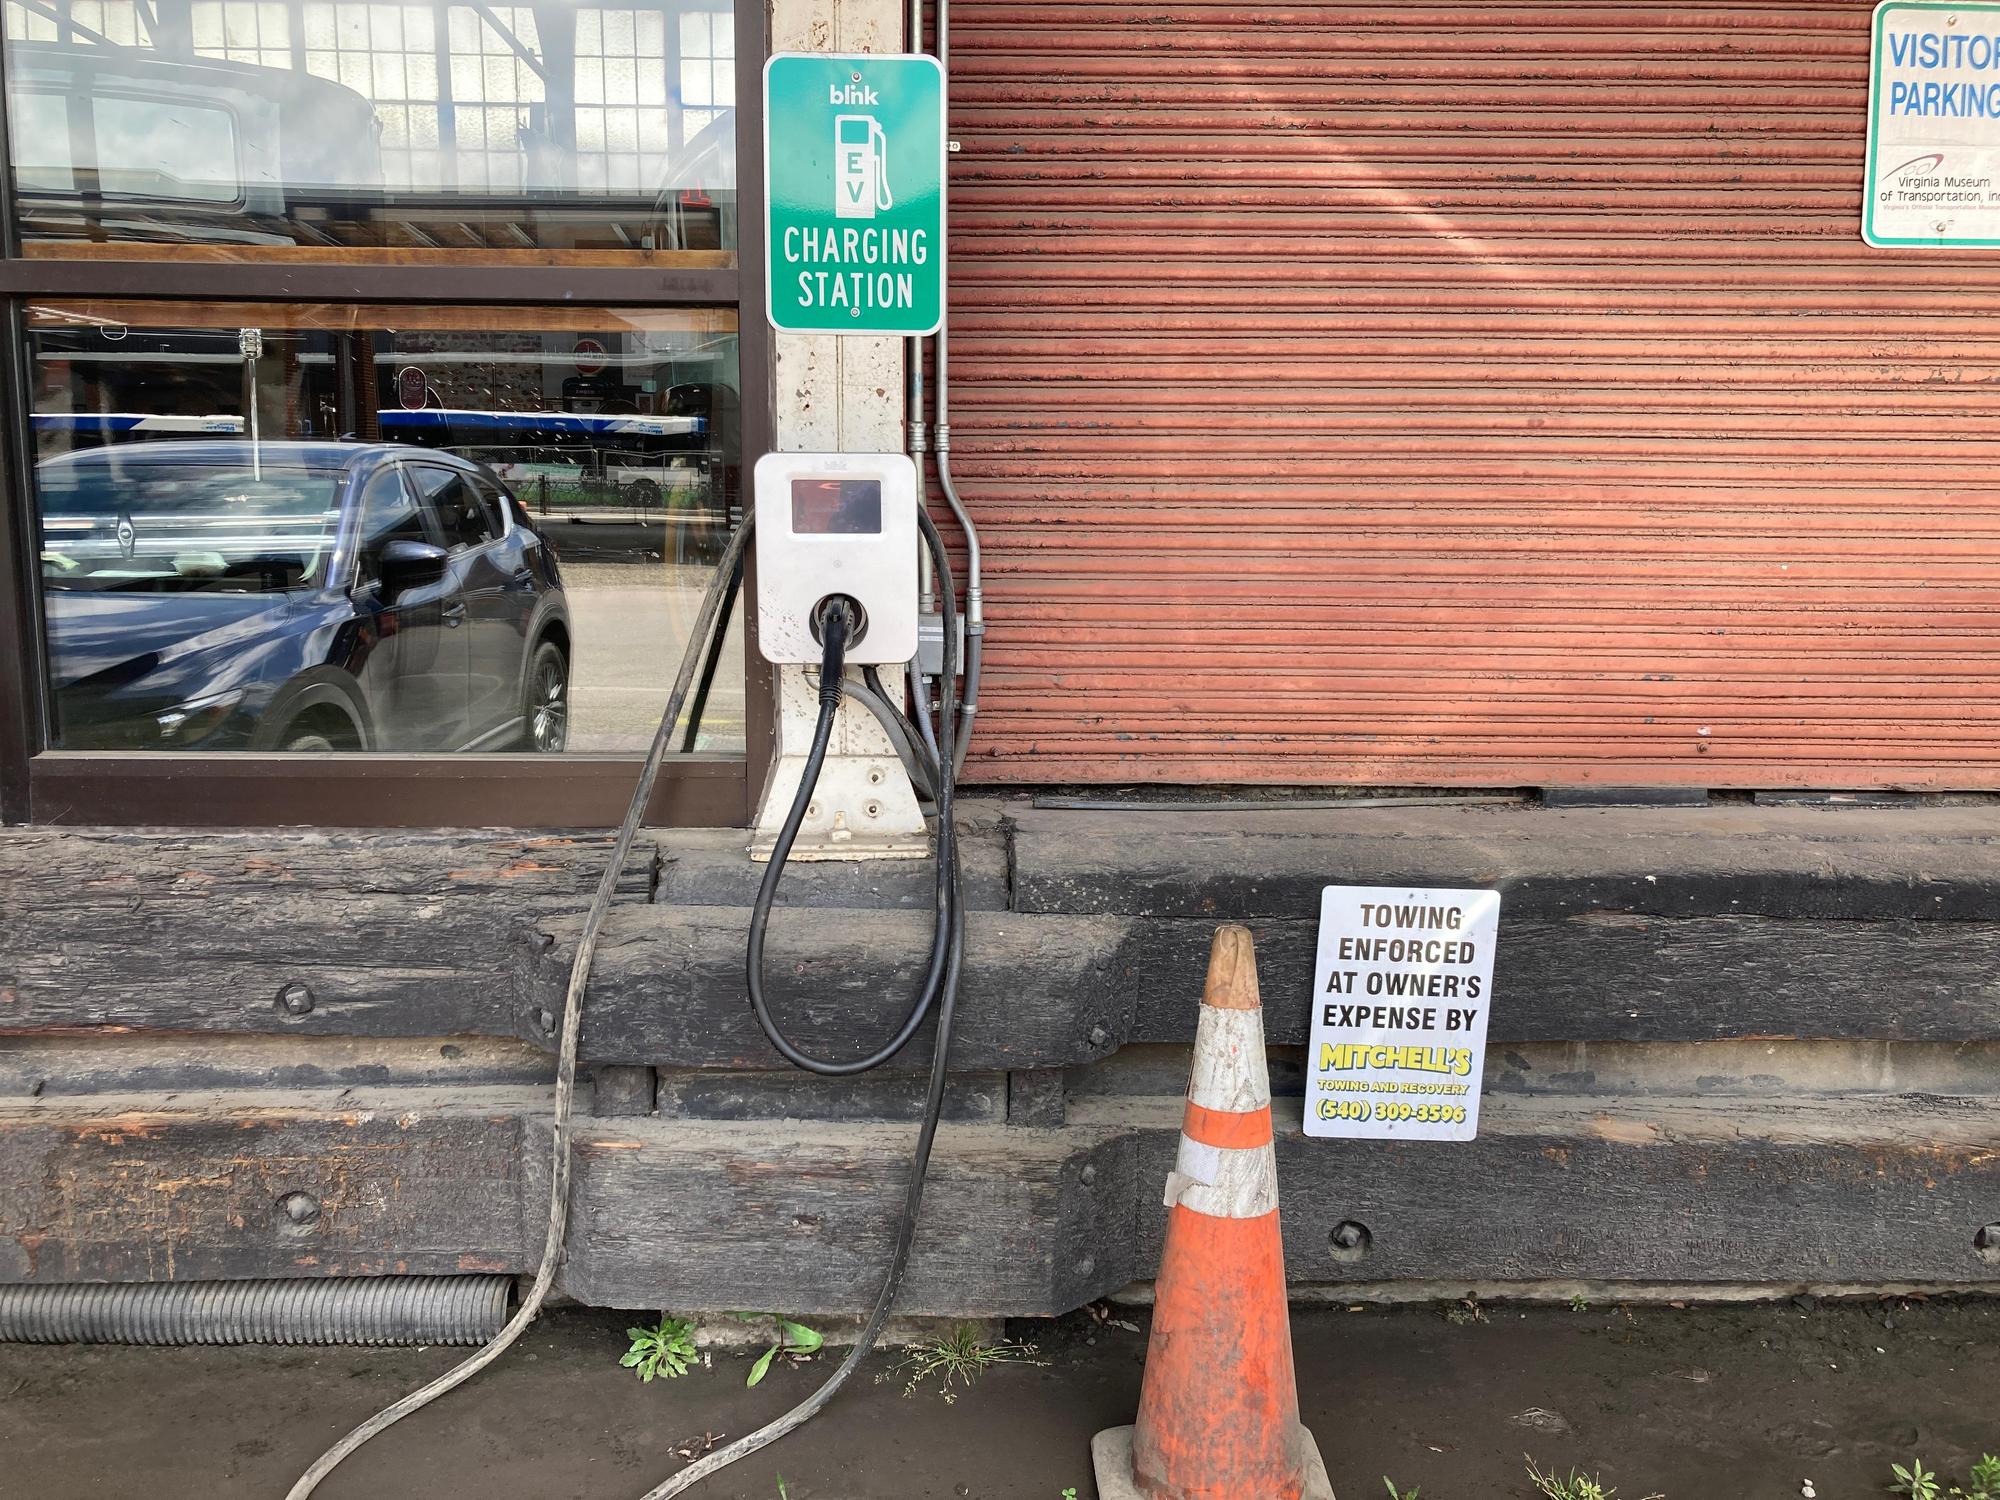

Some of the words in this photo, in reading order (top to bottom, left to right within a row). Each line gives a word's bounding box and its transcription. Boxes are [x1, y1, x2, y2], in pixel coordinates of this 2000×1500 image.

[829, 84, 879, 105] blink
[1898, 176, 1940, 189] Virginia
[1944, 177, 1991, 187] Museum
[1880, 191, 1893, 201] of
[1897, 191, 1984, 204] Transportation,
[783, 226, 928, 265] CHARGING
[798, 271, 913, 309] STATION
[1360, 904, 1462, 930] TOWING
[1338, 937, 1476, 965] ENFORCED
[1326, 971, 1358, 994] AT
[1366, 972, 1482, 998] OWNER'S
[1322, 1004, 1437, 1030] EXPENSE
[1445, 1008, 1478, 1031] BY
[1319, 1043, 1473, 1077] MITCHELL'S
[1317, 1079, 1370, 1092] TOWING
[1371, 1081, 1399, 1093] AND
[1400, 1082, 1470, 1096] RECOVERY
[1315, 1100, 1372, 1122] (540)
[1374, 1102, 1467, 1124] 309-3596
